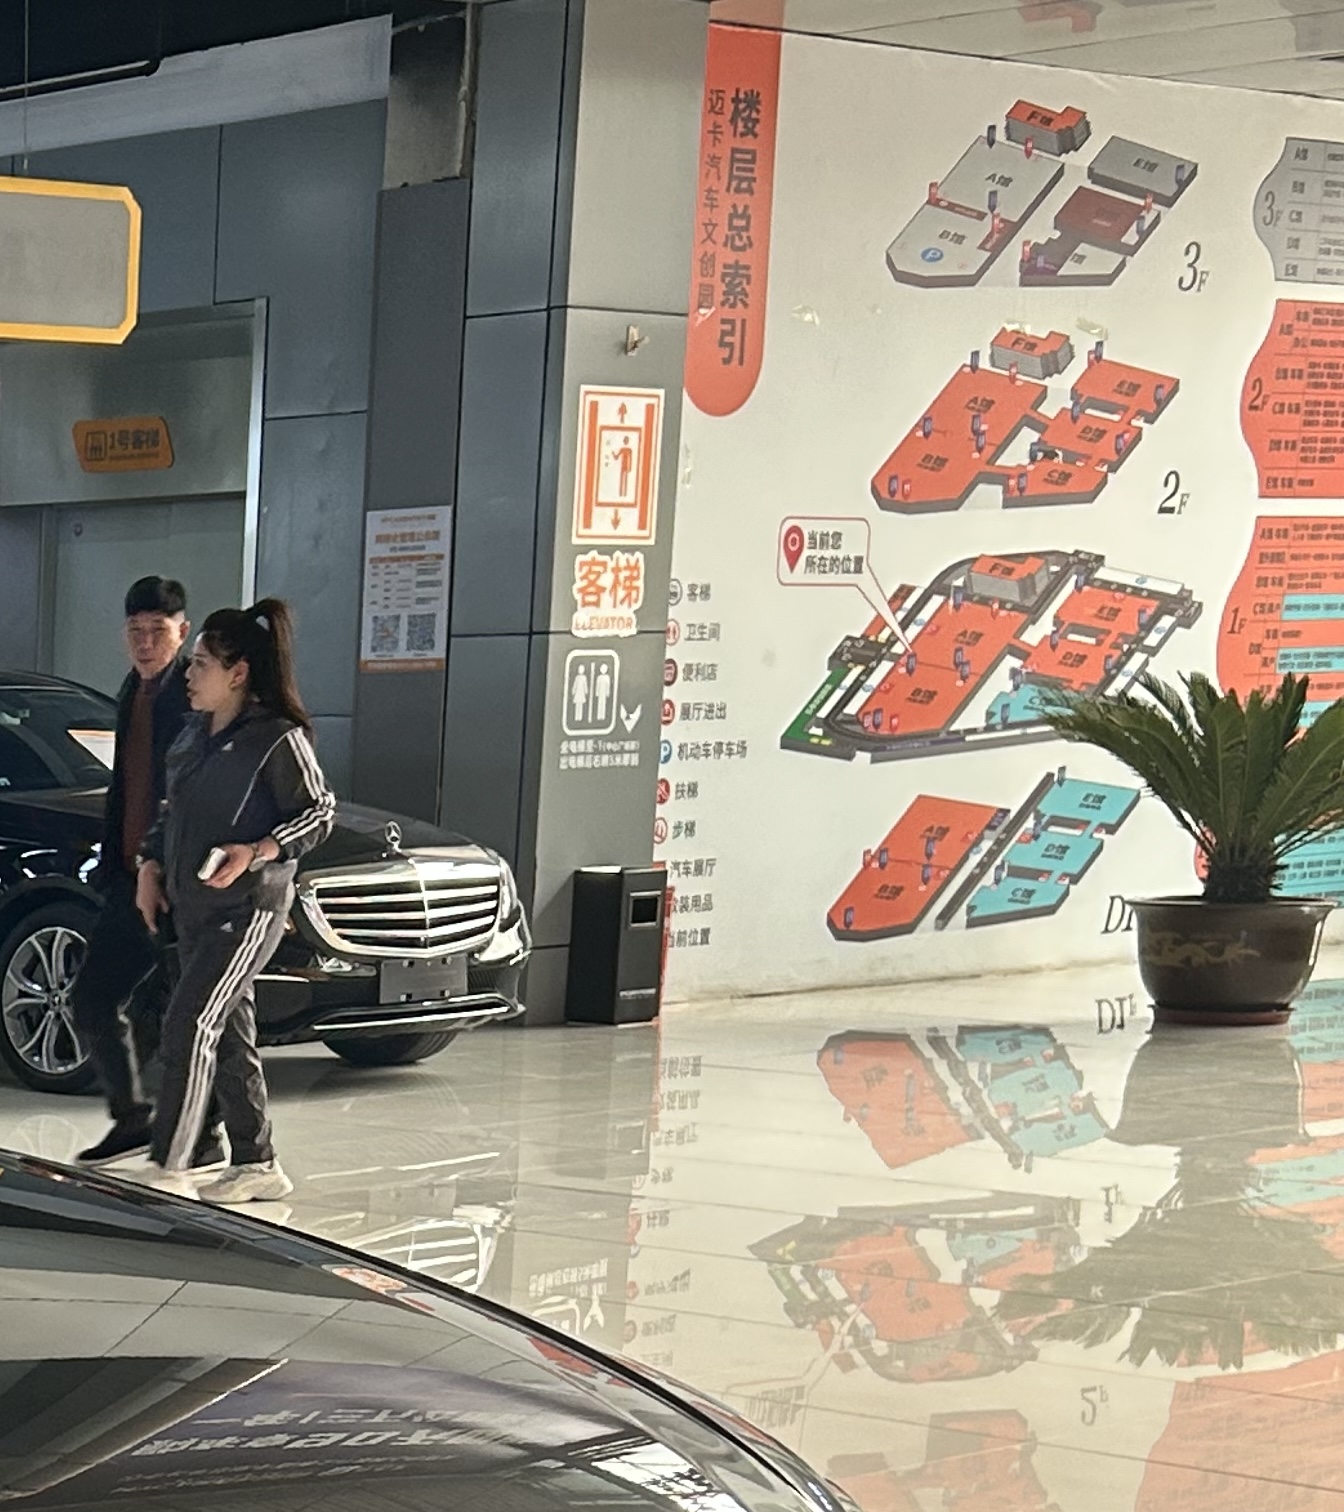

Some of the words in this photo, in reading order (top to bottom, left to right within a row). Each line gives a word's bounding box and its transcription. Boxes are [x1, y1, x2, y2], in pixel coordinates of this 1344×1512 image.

[717, 88, 762, 367] 楼层总索引
[1157, 470, 1190, 515] 2F
[807, 530, 843, 549] 当前您
[803, 554, 864, 576] 所在的位置
[576, 556, 641, 609] 客梯
[686, 583, 711, 602] 客梯
[684, 622, 721, 642] 卫生间
[682, 663, 718, 682] 便利店
[679, 702, 728, 721] 展厅进出
[677, 740, 748, 761] 机动车停车场
[675, 781, 699, 800] 扶梯
[672, 820, 696, 840] 步梯
[670, 858, 717, 879] 汽车展厅
